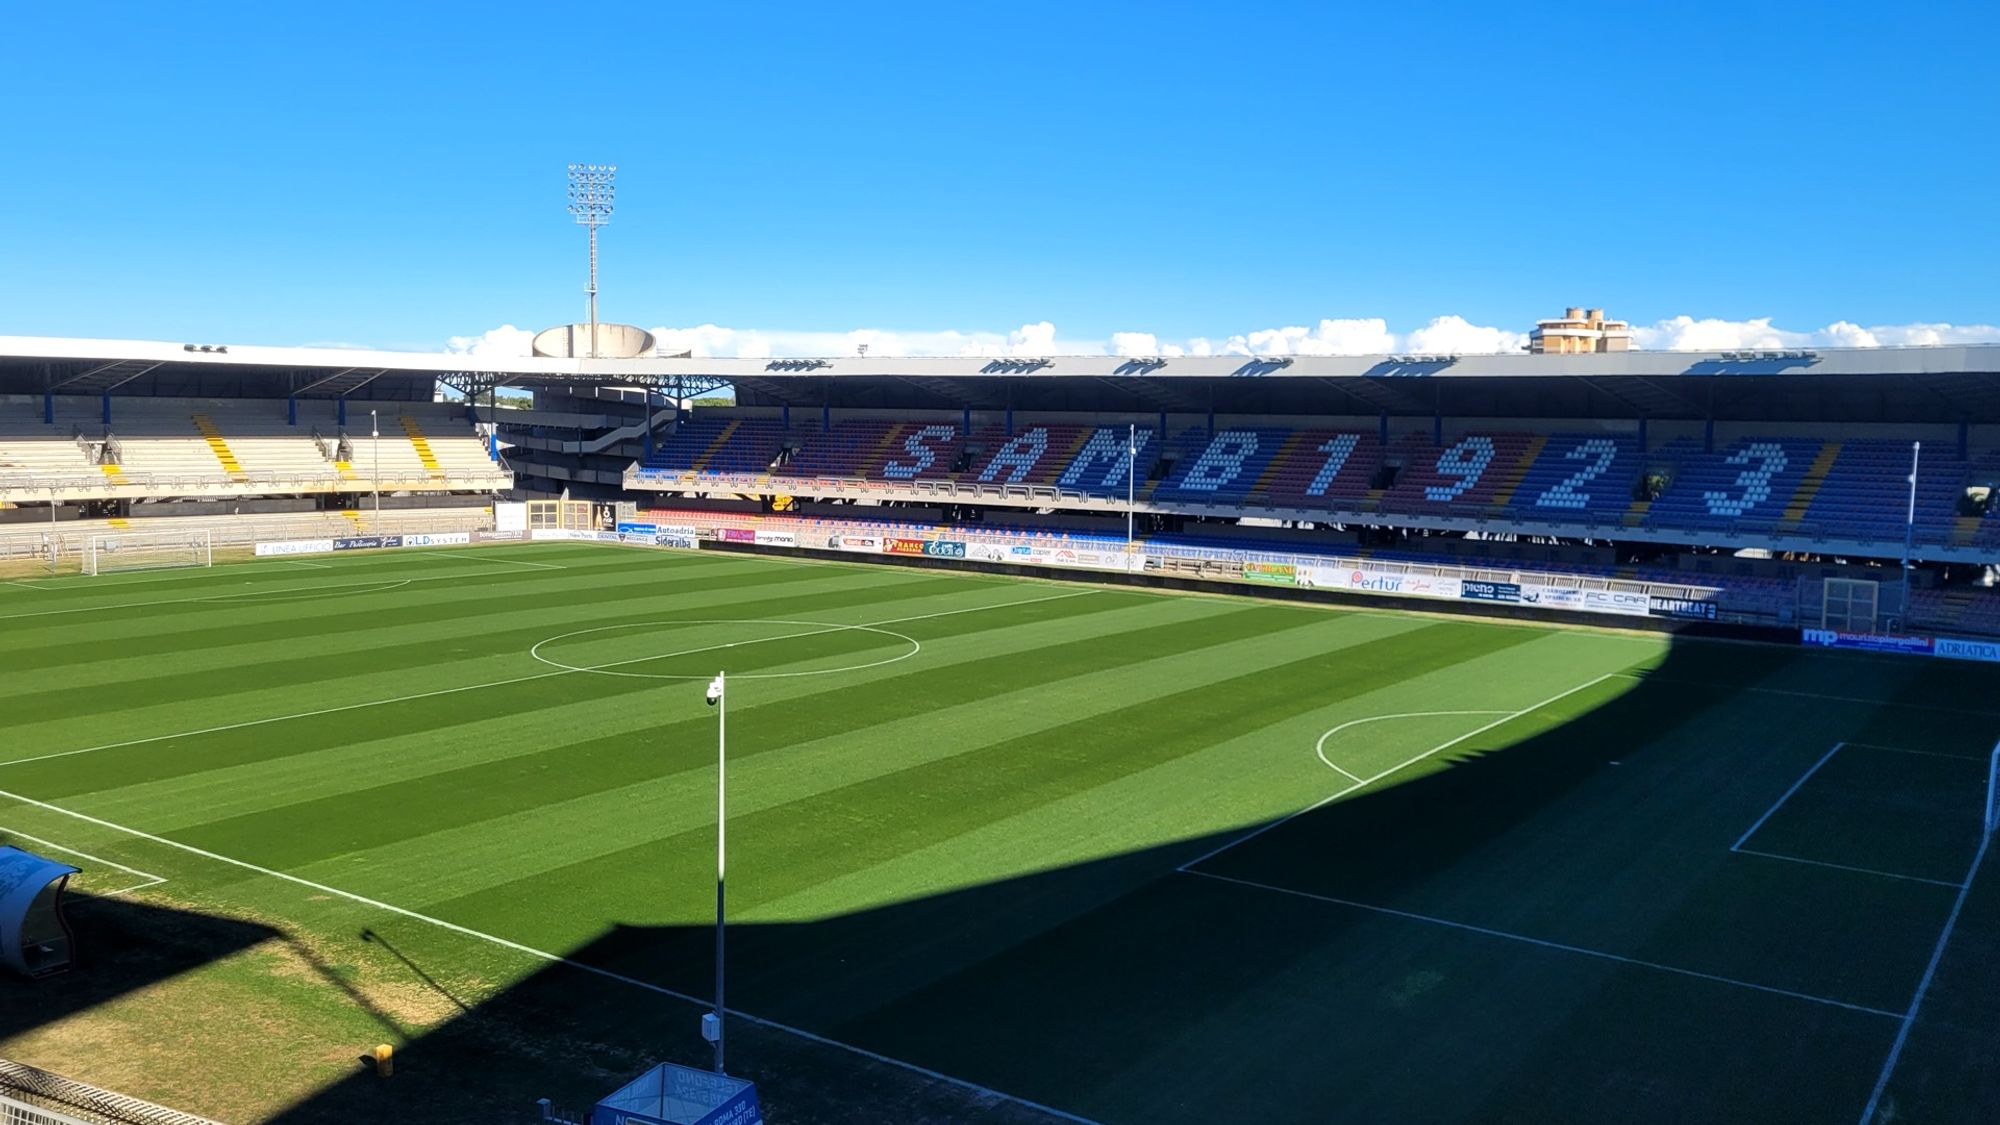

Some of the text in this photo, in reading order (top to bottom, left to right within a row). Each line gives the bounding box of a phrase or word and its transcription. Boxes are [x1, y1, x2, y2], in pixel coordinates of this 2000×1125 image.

[883, 425, 1788, 516] SAMB 1923
[657, 526, 694, 535] Autoadria
[655, 535, 691, 548] Sideralba
[1586, 592, 1607, 601] FC
[1613, 594, 1647, 605] CAR
[1650, 600, 1707, 614] HEARTBEAT
[1803, 629, 1838, 645] mp
[1938, 642, 1997, 658] ADRIATICA
